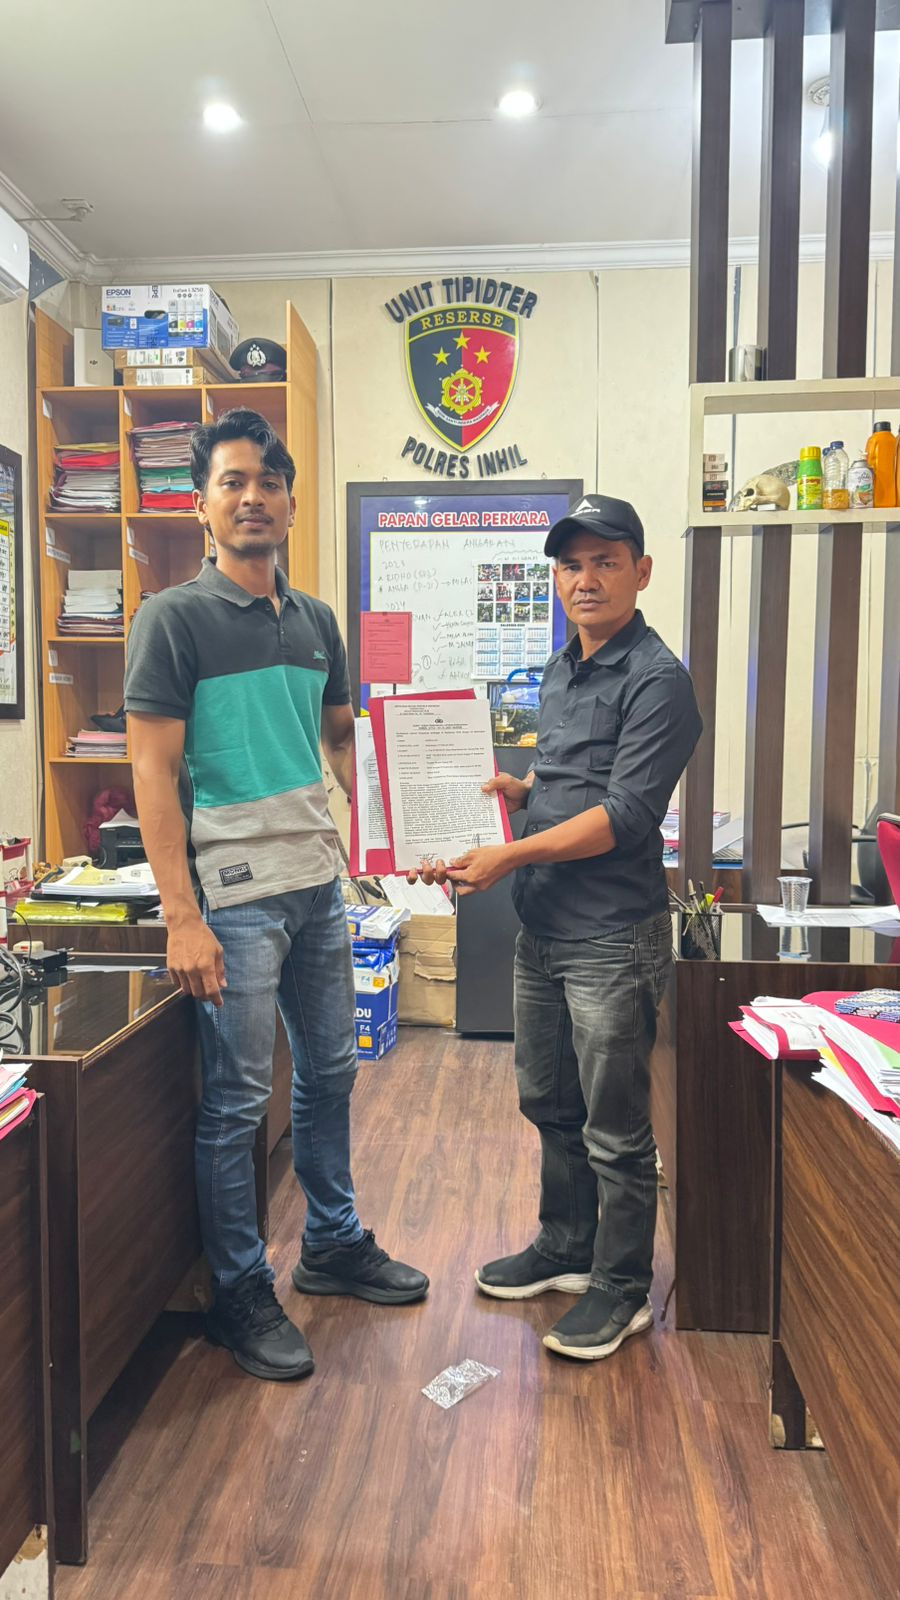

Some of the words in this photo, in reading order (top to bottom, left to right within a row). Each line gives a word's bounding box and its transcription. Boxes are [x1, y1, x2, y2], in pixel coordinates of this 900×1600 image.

[384, 280, 433, 323] UNIT
[442, 276, 538, 318] TIPIDTER
[420, 311, 504, 330] RESERSE
[401, 436, 470, 479] POLRES
[477, 444, 528, 478] INHIL
[379, 512, 427, 527] PAPAN
[431, 512, 479, 527] GELAR
[482, 511, 550, 527] PERKARA
[355, 1008, 372, 1018] DU
